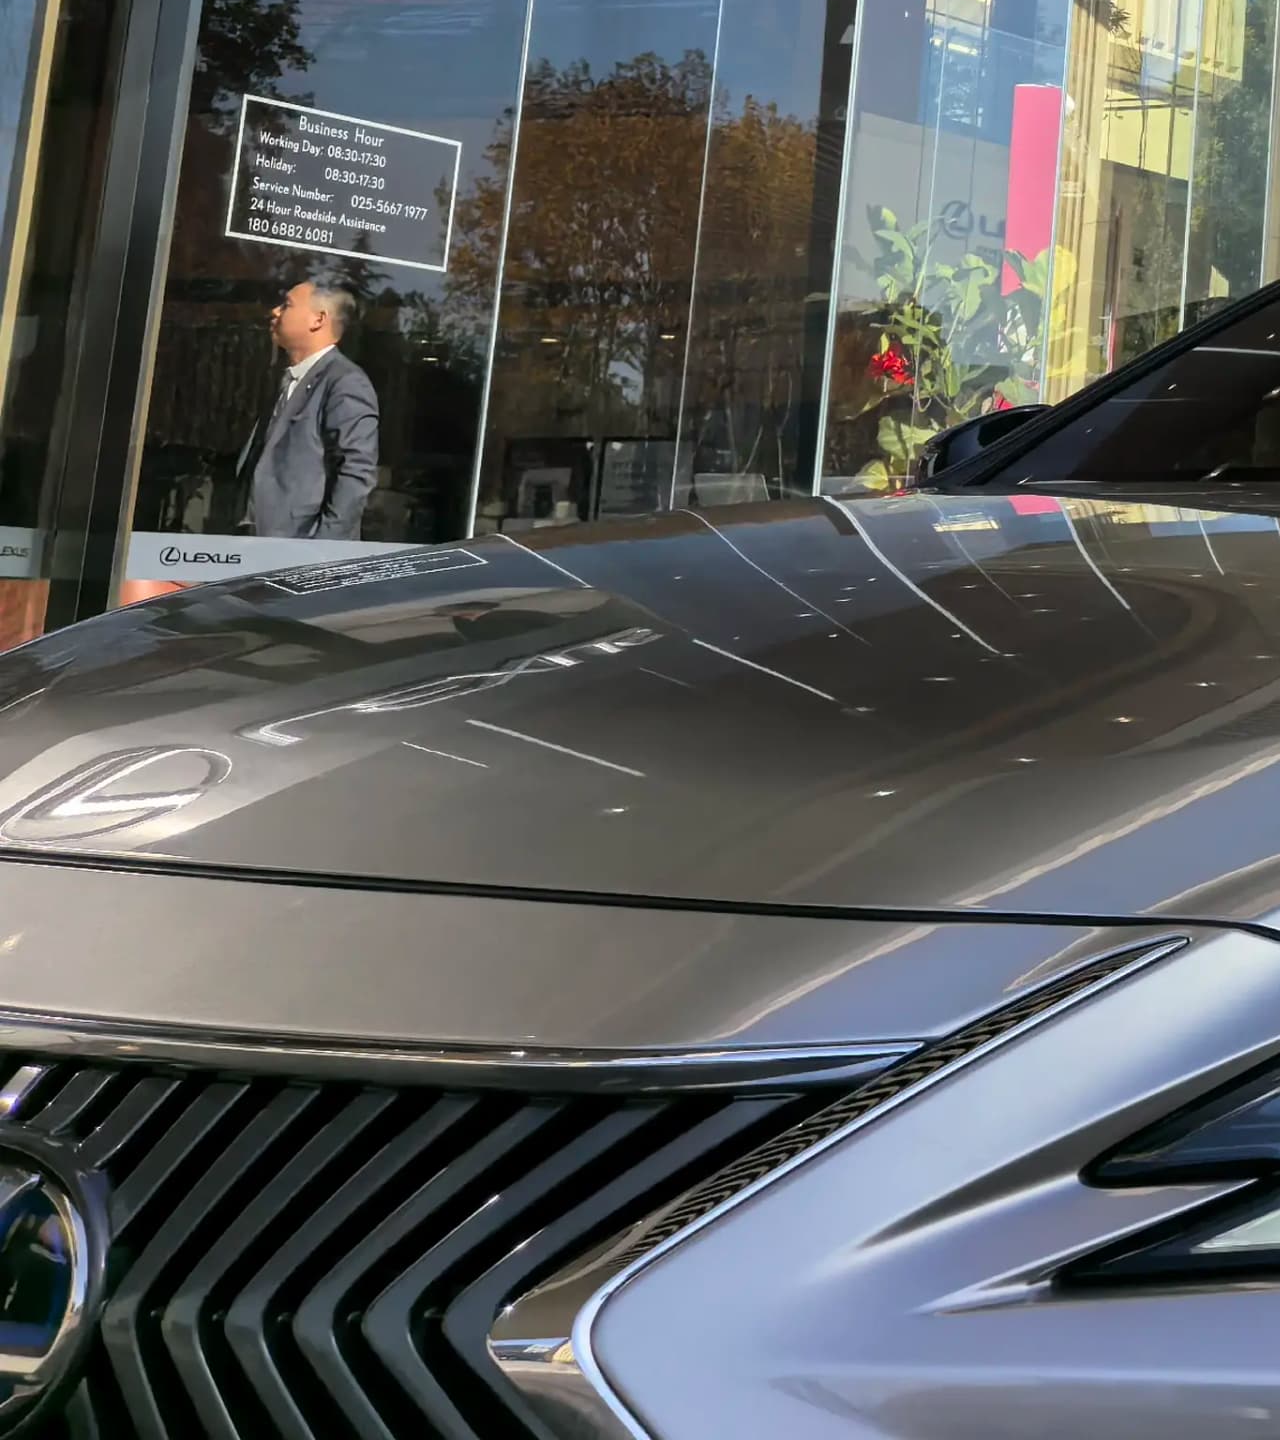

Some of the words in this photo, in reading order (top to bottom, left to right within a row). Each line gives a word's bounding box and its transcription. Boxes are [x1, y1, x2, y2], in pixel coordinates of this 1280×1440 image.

[299, 115, 349, 140] Business
[355, 128, 384, 148] Hour
[260, 131, 300, 153] Working
[302, 139, 324, 157] Day:
[327, 145, 387, 168] 08:30-17:30
[255, 154, 297, 173] Holiday:
[324, 167, 385, 190] 08:30-17:30
[253, 177, 290, 195] Service
[291, 186, 334, 203] Number:
[248, 217, 269, 232] 180
[271, 221, 303, 238] 6882
[305, 227, 334, 244] 6081
[250, 198, 264, 211] 24
[266, 200, 292, 216] Hour
[294, 206, 337, 225] Roadside
[339, 214, 386, 233] Assistance
[183, 552, 242, 564] LEXUS
